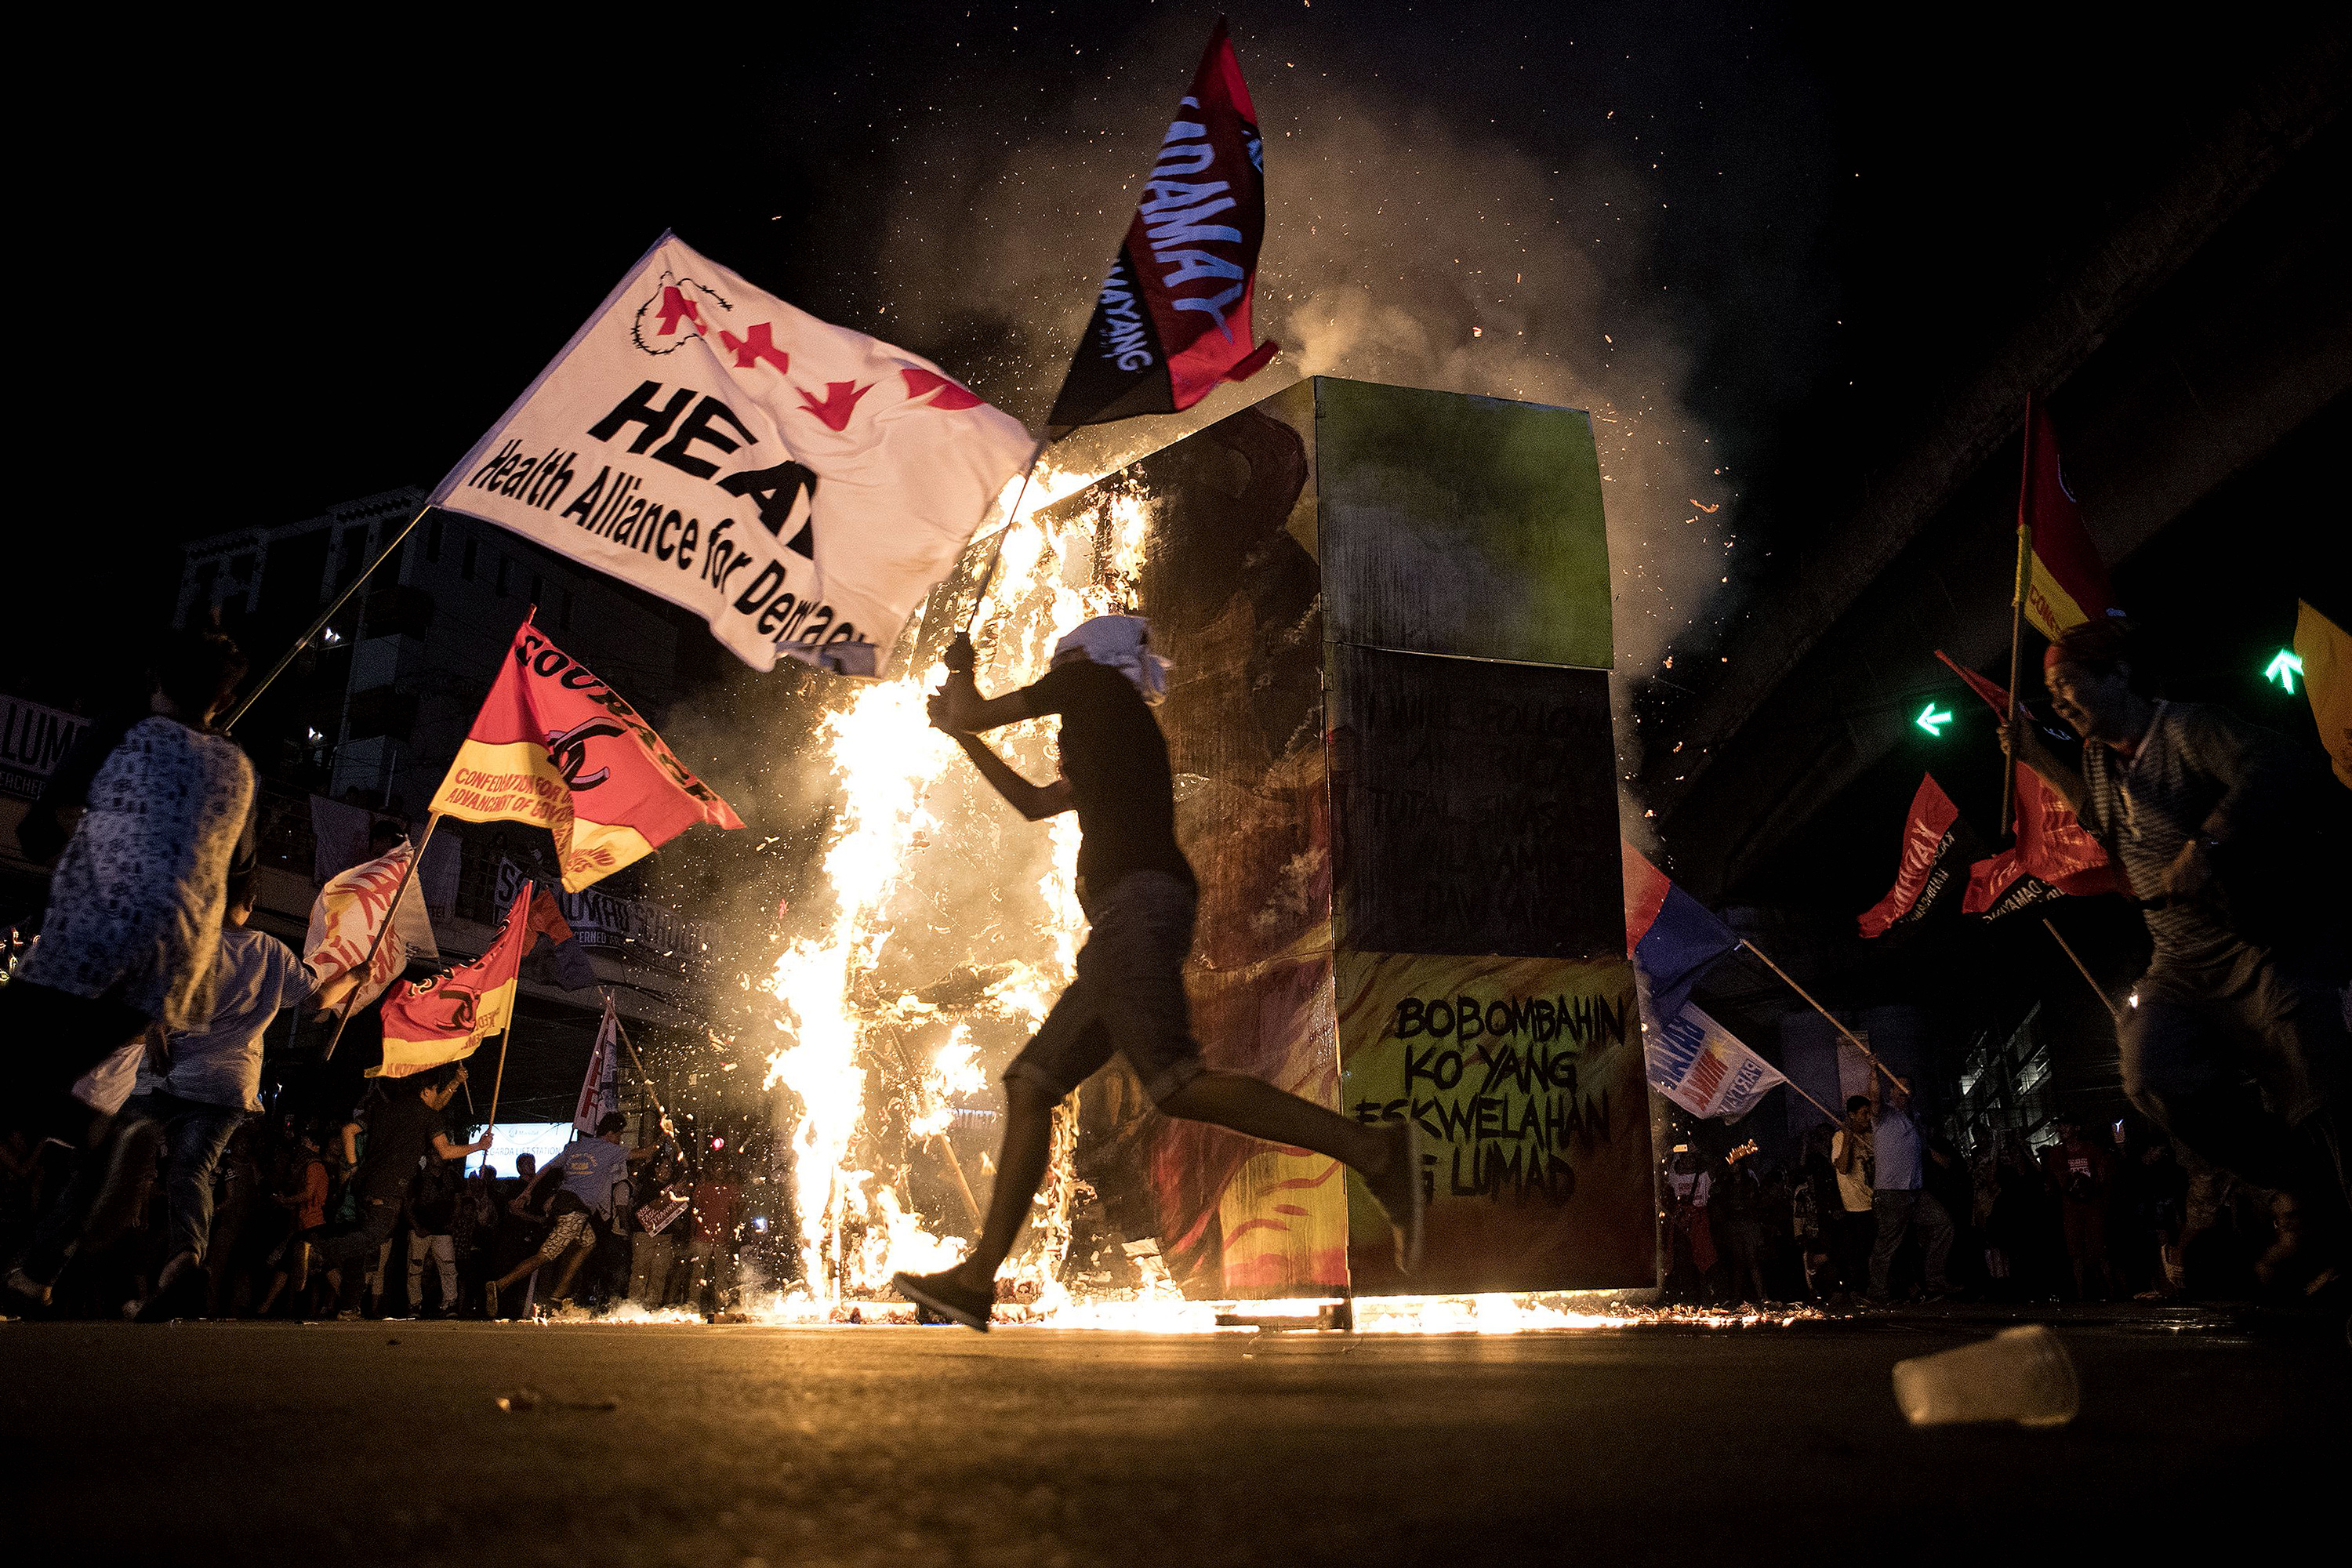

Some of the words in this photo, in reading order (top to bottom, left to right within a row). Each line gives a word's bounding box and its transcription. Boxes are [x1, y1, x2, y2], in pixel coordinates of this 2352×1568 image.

[586, 379, 817, 561] HEA
[467, 438, 579, 512] Health
[560, 465, 699, 571] Alliance
[699, 517, 753, 594] for
[512, 796, 543, 813] OF
[1396, 994, 1626, 1046] BOBOMBAHIN
[1403, 1044, 1464, 1095] KO
[1475, 1044, 1579, 1095] YANG
